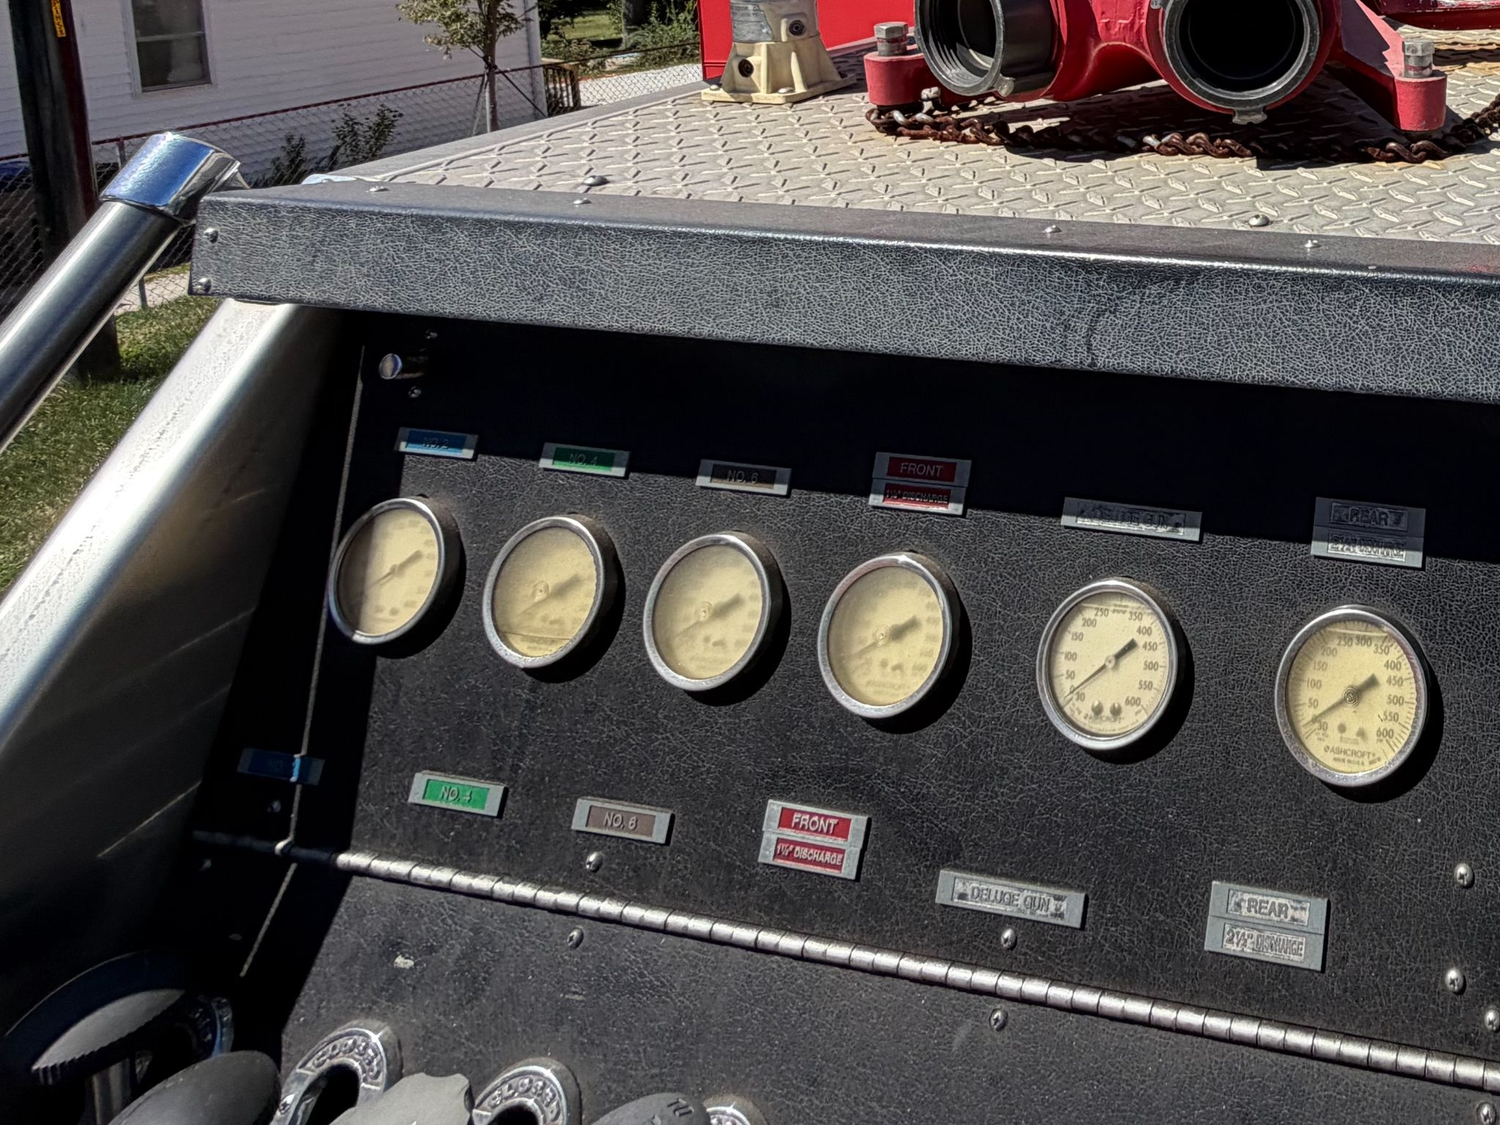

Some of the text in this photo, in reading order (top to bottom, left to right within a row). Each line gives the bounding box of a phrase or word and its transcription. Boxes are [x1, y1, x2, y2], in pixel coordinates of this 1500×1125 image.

[588, 455, 598, 467] 4
[899, 462, 944, 477] FRONT
[901, 490, 950, 504] DISCHARGE
[1094, 607, 1110, 617] 250
[1128, 611, 1144, 622] 350
[1081, 618, 1098, 628] 200
[1136, 625, 1153, 636] 400
[1071, 632, 1084, 642] 150
[1337, 637, 1353, 648] 250
[1355, 636, 1373, 647] 300
[1142, 642, 1158, 651] 450
[1321, 646, 1338, 657] 200
[1373, 644, 1390, 655] 350
[1064, 651, 1078, 662] 100
[1143, 661, 1159, 671] 500
[1312, 661, 1328, 672] 150
[1383, 659, 1402, 671] 400
[1065, 670, 1076, 680] 50
[1138, 680, 1154, 691] 550
[1306, 679, 1322, 689] 100
[1386, 676, 1404, 687] 450
[1124, 696, 1141, 707] 600
[1307, 698, 1319, 709] 50
[1386, 695, 1405, 706] 500
[1383, 711, 1400, 723] 550
[1317, 721, 1329, 732] 30
[1376, 727, 1394, 739] 600
[440, 785, 462, 802] NO.
[603, 811, 638, 830] NO. 6
[791, 812, 839, 836] FRONT
[793, 846, 844, 867] DISCHARGE
[970, 885, 1052, 914] DELUGE GUN
[1246, 897, 1290, 919] REAR
